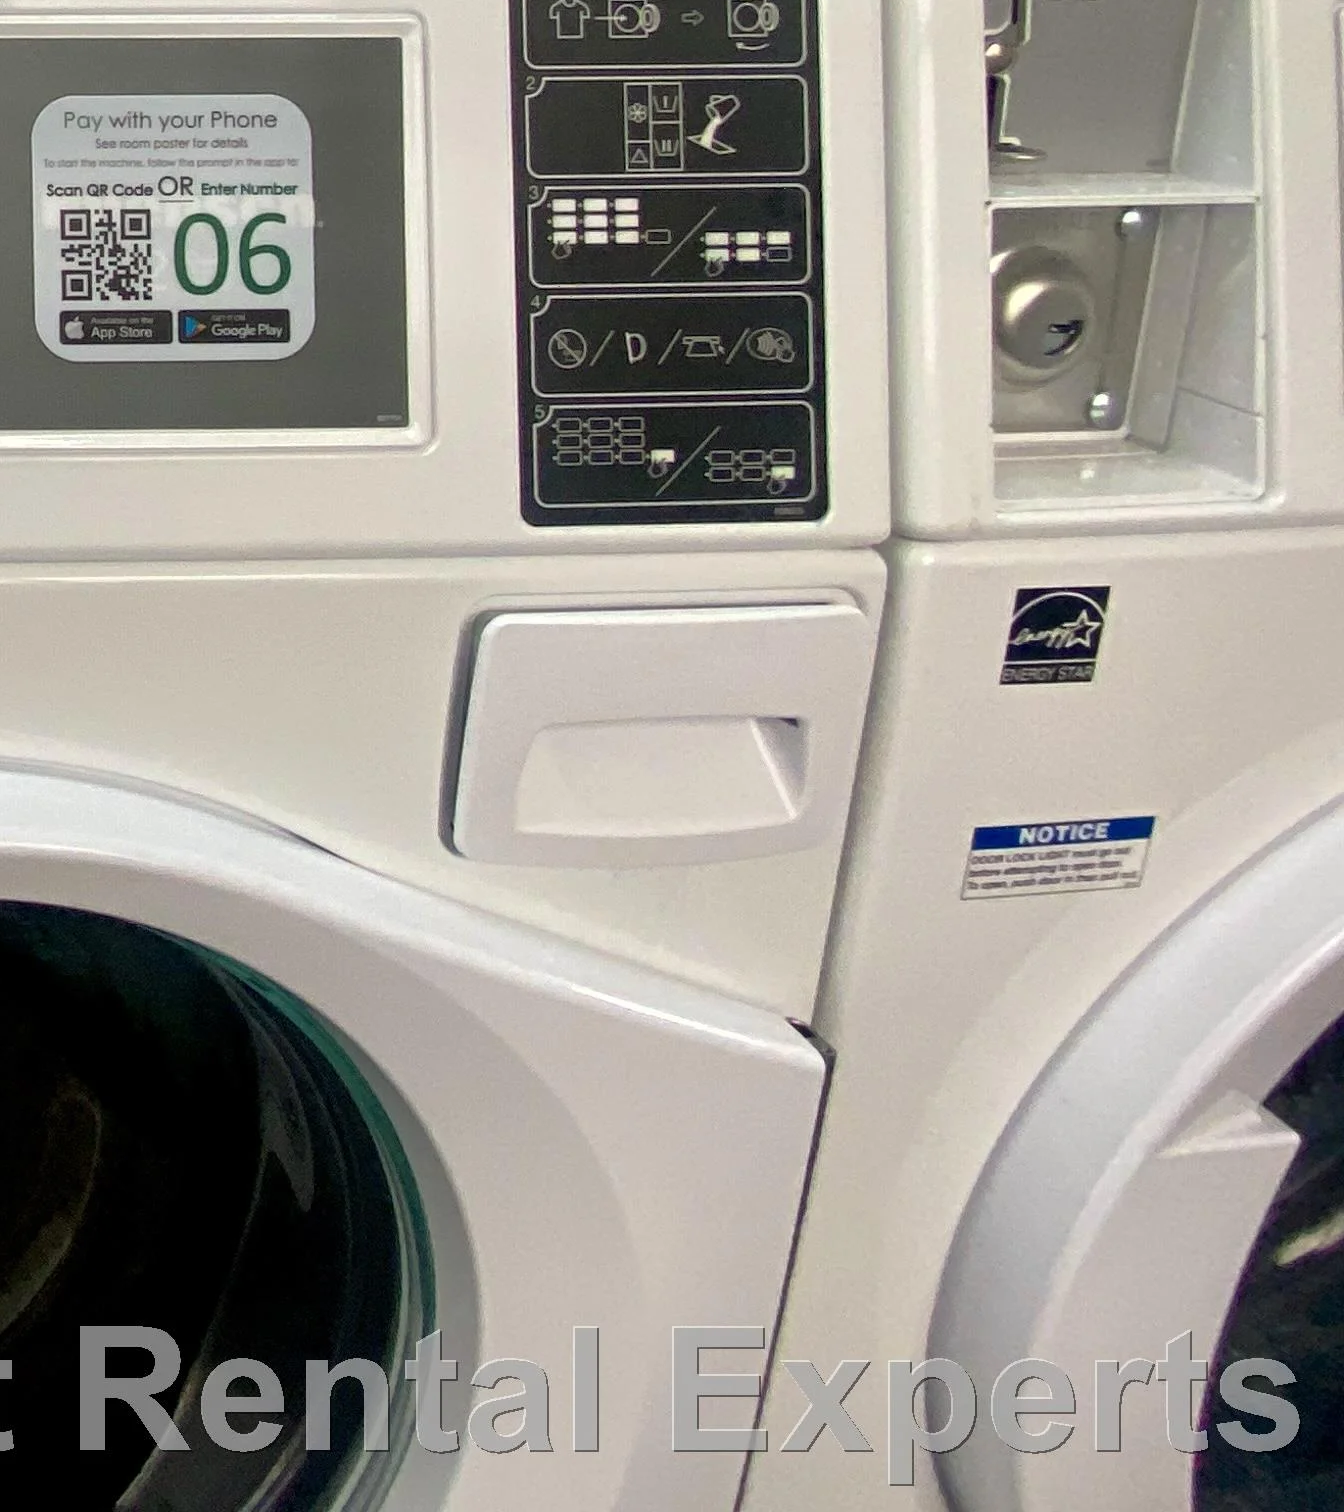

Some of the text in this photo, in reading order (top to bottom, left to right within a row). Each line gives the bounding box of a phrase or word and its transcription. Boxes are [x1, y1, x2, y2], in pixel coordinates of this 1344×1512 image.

[63, 110, 278, 132] Pay with your Phone
[95, 138, 248, 150] See room poster for details
[47, 176, 297, 196] Scan QR Code OR Enter Number
[174, 212, 291, 295] 06
[91, 326, 152, 339] App Store
[211, 324, 283, 338] Google Play
[1018, 822, 1110, 845] NOTICE
